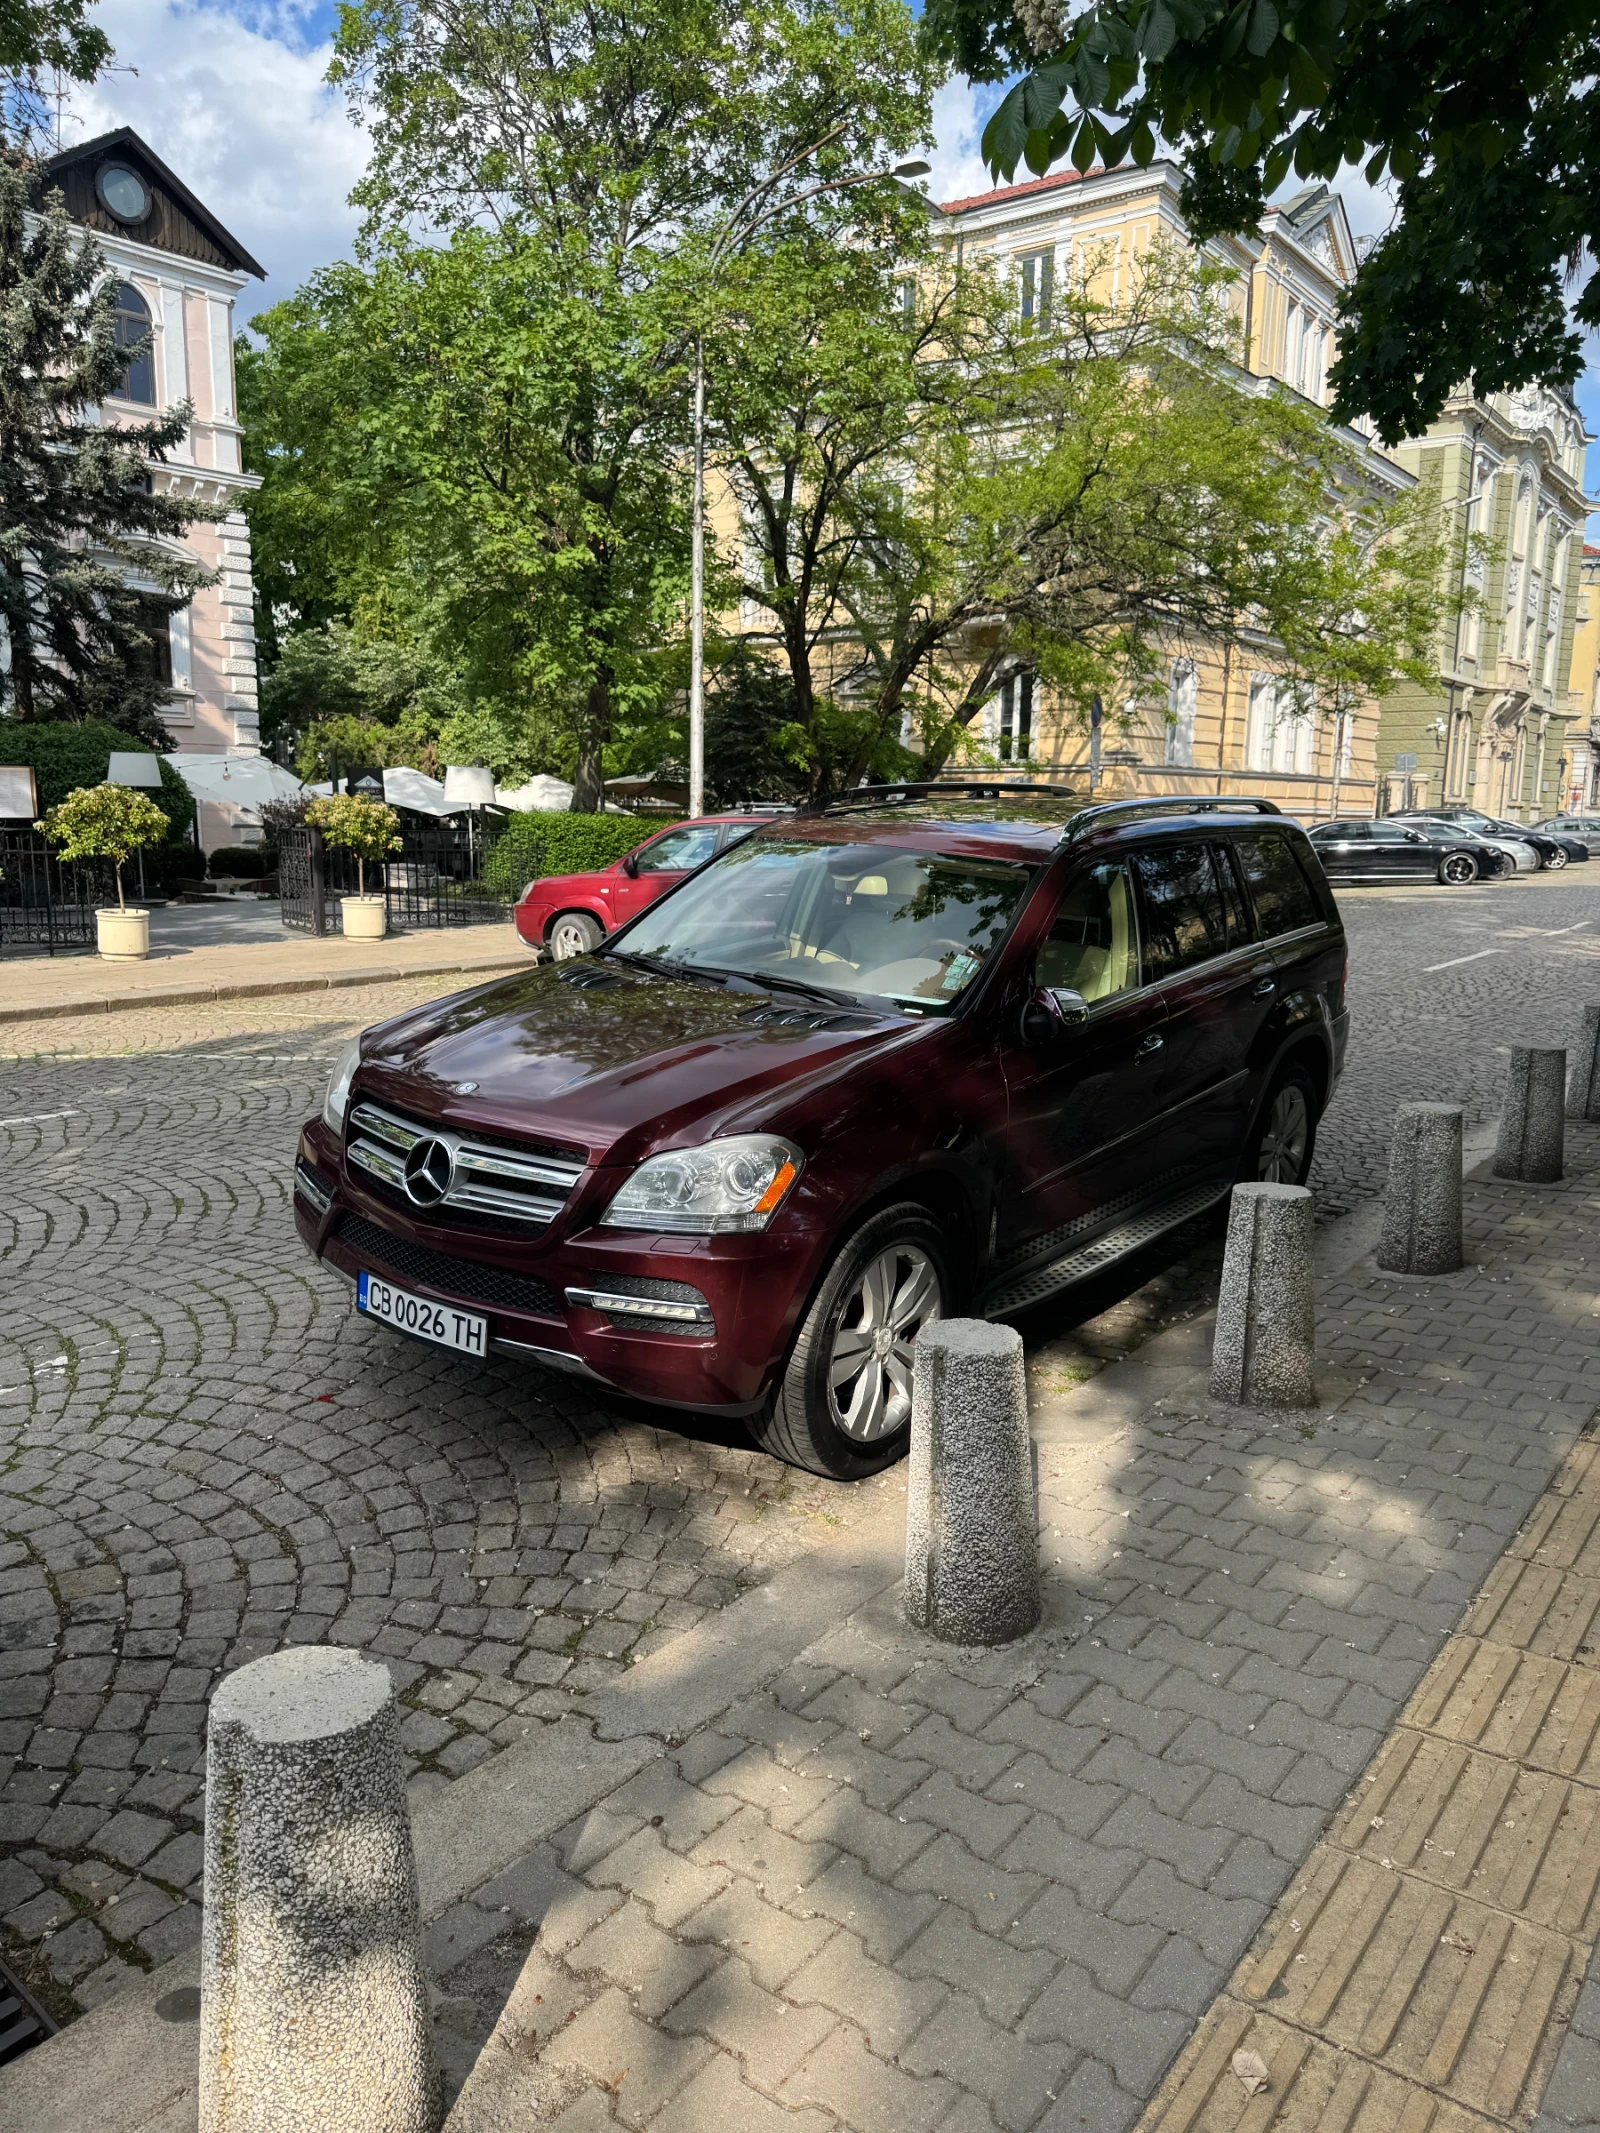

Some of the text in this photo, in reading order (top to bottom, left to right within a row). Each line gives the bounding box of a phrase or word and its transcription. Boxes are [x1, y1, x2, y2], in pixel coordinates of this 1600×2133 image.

[370, 1282, 482, 1352] CB 0026 TH
